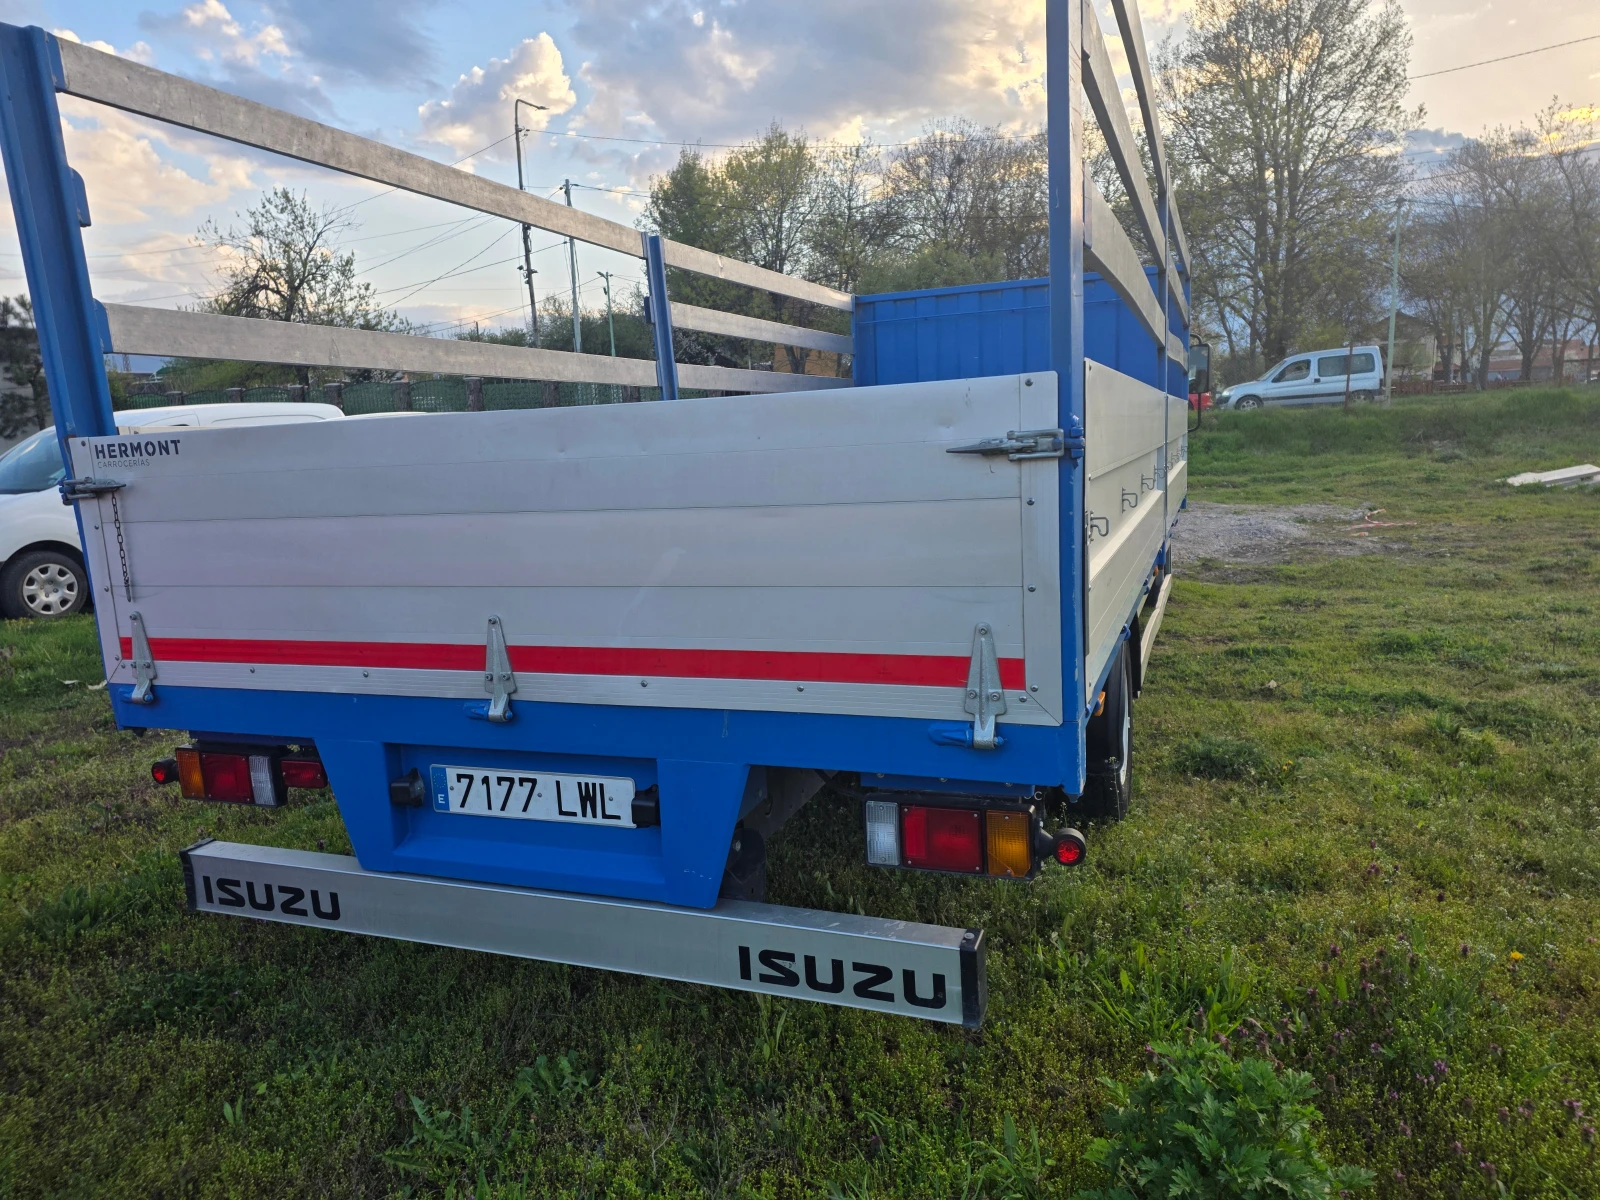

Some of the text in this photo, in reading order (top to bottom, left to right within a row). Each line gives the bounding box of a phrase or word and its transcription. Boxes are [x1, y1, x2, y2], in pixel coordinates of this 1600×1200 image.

[94, 439, 181, 460] HERMONT
[97, 458, 150, 469] CARROCERÍAS
[437, 773, 622, 820] E 7177 LWL
[202, 875, 341, 921] ISUZU
[738, 945, 947, 1010] ISUZU
